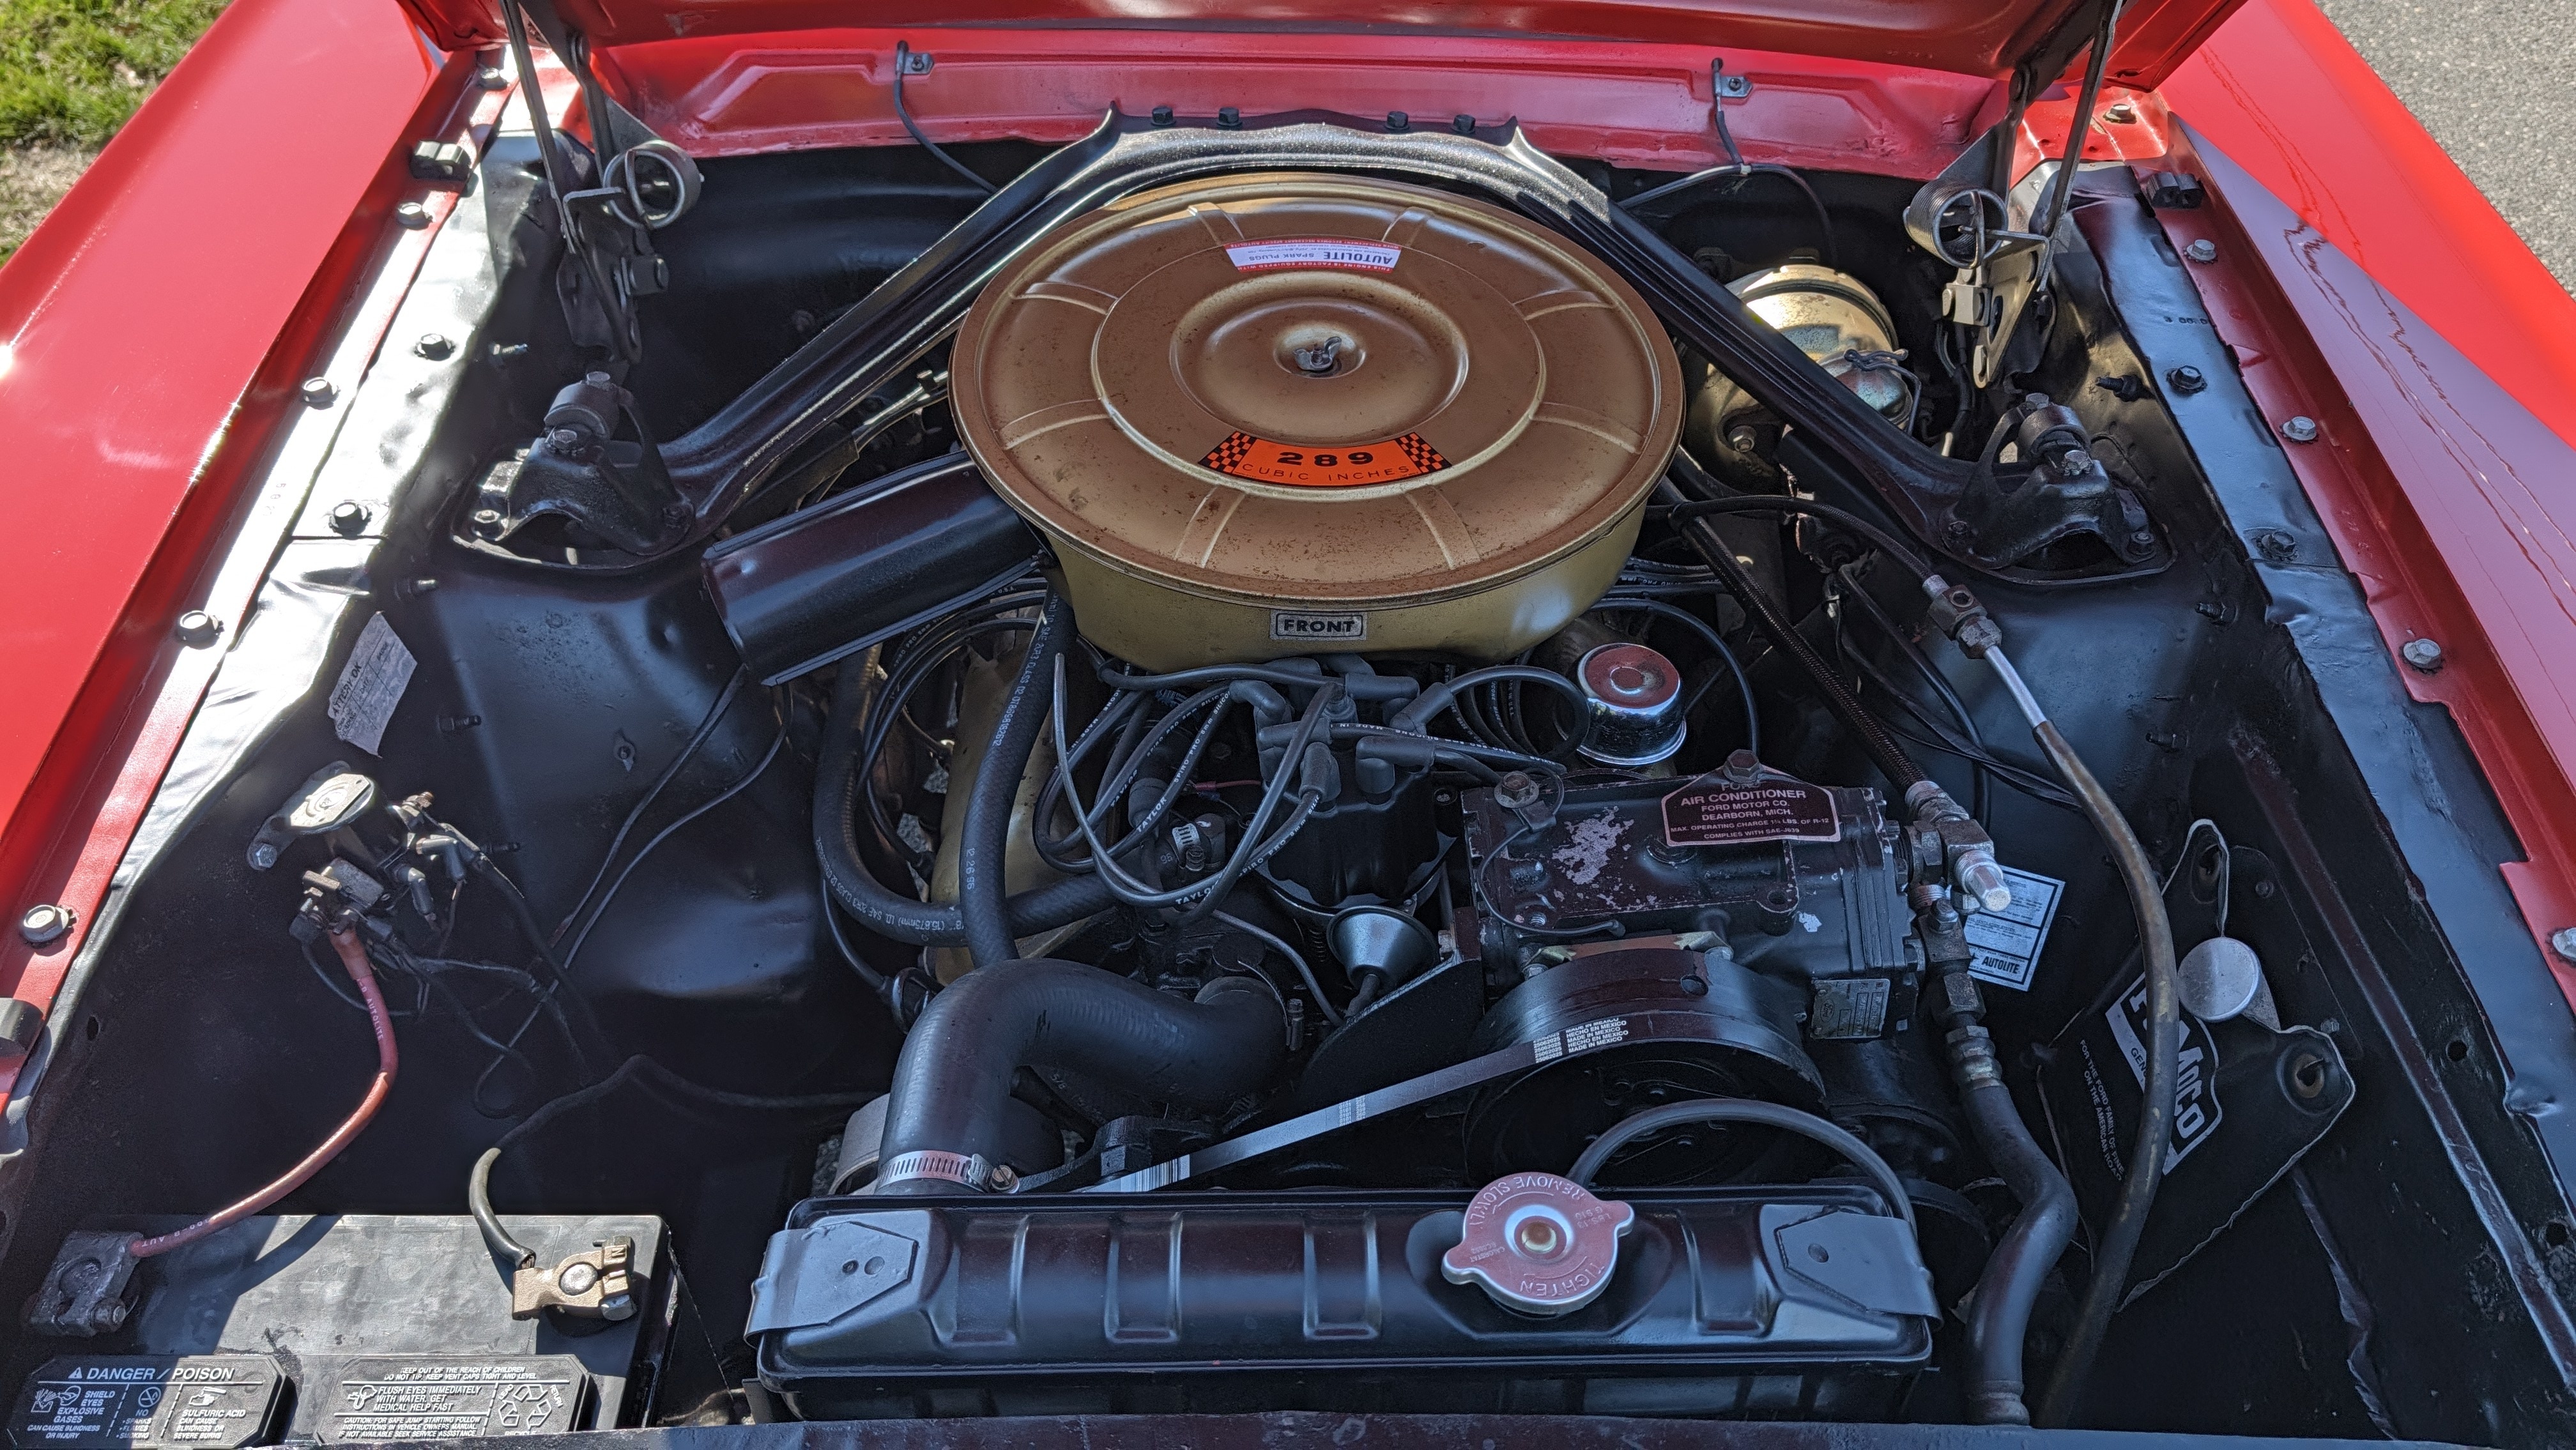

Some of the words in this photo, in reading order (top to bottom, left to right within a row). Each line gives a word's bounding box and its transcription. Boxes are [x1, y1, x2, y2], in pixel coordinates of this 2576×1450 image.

[1323, 251, 1393, 264] AUTOLITE
[1276, 452, 1374, 467] 289
[1241, 463, 1309, 480] CUBIC
[1328, 465, 1411, 481] INCHES
[1284, 619, 1355, 632] FRONT
[351, 662, 362, 678] OK
[1110, 768, 1138, 807] TAYLOR
[1166, 721, 1179, 735] PRO
[1136, 797, 1168, 833] TAYLOR
[1174, 759, 1190, 783] SPIRO
[1190, 738, 1201, 756] PRO
[1200, 717, 1214, 735] 8mm
[1680, 795, 1705, 806] AIR
[1708, 790, 1807, 802] CONDITIONER
[1701, 803, 1730, 812] FORD
[1733, 800, 1770, 810] MOTOR
[1772, 799, 1790, 807] CO.
[1702, 811, 1763, 821] DEARBORN,
[1765, 808, 1794, 817] MICH.
[1691, 822, 1735, 830] OPERATING
[1736, 820, 1769, 828] CHARGE
[1704, 831, 1743, 839] COMPLIES
[965, 860, 976, 875] 26
[1176, 885, 1215, 904] TAYLO
[1268, 839, 1287, 857] PRO
[1289, 818, 1306, 837] 8mm
[868, 906, 883, 920] SAE
[1981, 956, 2020, 974] AUTOLITE
[366, 998, 383, 1041] AUTOLITE
[1566, 1028, 1589, 1038] HECHO
[1600, 1020, 1627, 1030] MEXICO
[1567, 1034, 1586, 1043] MADE
[1595, 1026, 1621, 1036] MEXICO
[1568, 1038, 1591, 1048] HECHO
[1602, 1030, 1629, 1040] MEXICO
[1568, 1044, 1588, 1053] MADE
[1597, 1035, 1623, 1046] MEXICO
[2080, 1039, 2090, 1060] FOR
[2087, 1058, 2099, 1078] THE
[2095, 1079, 2110, 1106] FORD
[2083, 1069, 2094, 1086] ON
[2090, 1085, 2101, 1106] THE
[2096, 1106, 2109, 1153] AMERICAN
[2104, 1106, 2114, 1136] FAMILY
[2109, 1136, 2116, 1150] OF
[2111, 1150, 2125, 1175] FINE
[1513, 1175, 1586, 1201] REMOVE
[1520, 1262, 1605, 1297] TIGHTEN
[86, 1367, 156, 1380] DANGER
[172, 1368, 235, 1380] POISON
[84, 1390, 116, 1398] SHIELD
[378, 1386, 406, 1394] FLUSH
[406, 1386, 427, 1394] EYES
[429, 1385, 482, 1394] IMMEDIATELY
[498, 1384, 514, 1401] LEAD
[549, 1384, 564, 1408] RETURN
[57, 1407, 105, 1416] EXPLOSIVE
[181, 1409, 224, 1417] SULFURIC
[225, 1409, 246, 1417] ACID
[433, 1403, 454, 1411] FAST
[53, 1416, 84, 1424] GASES
